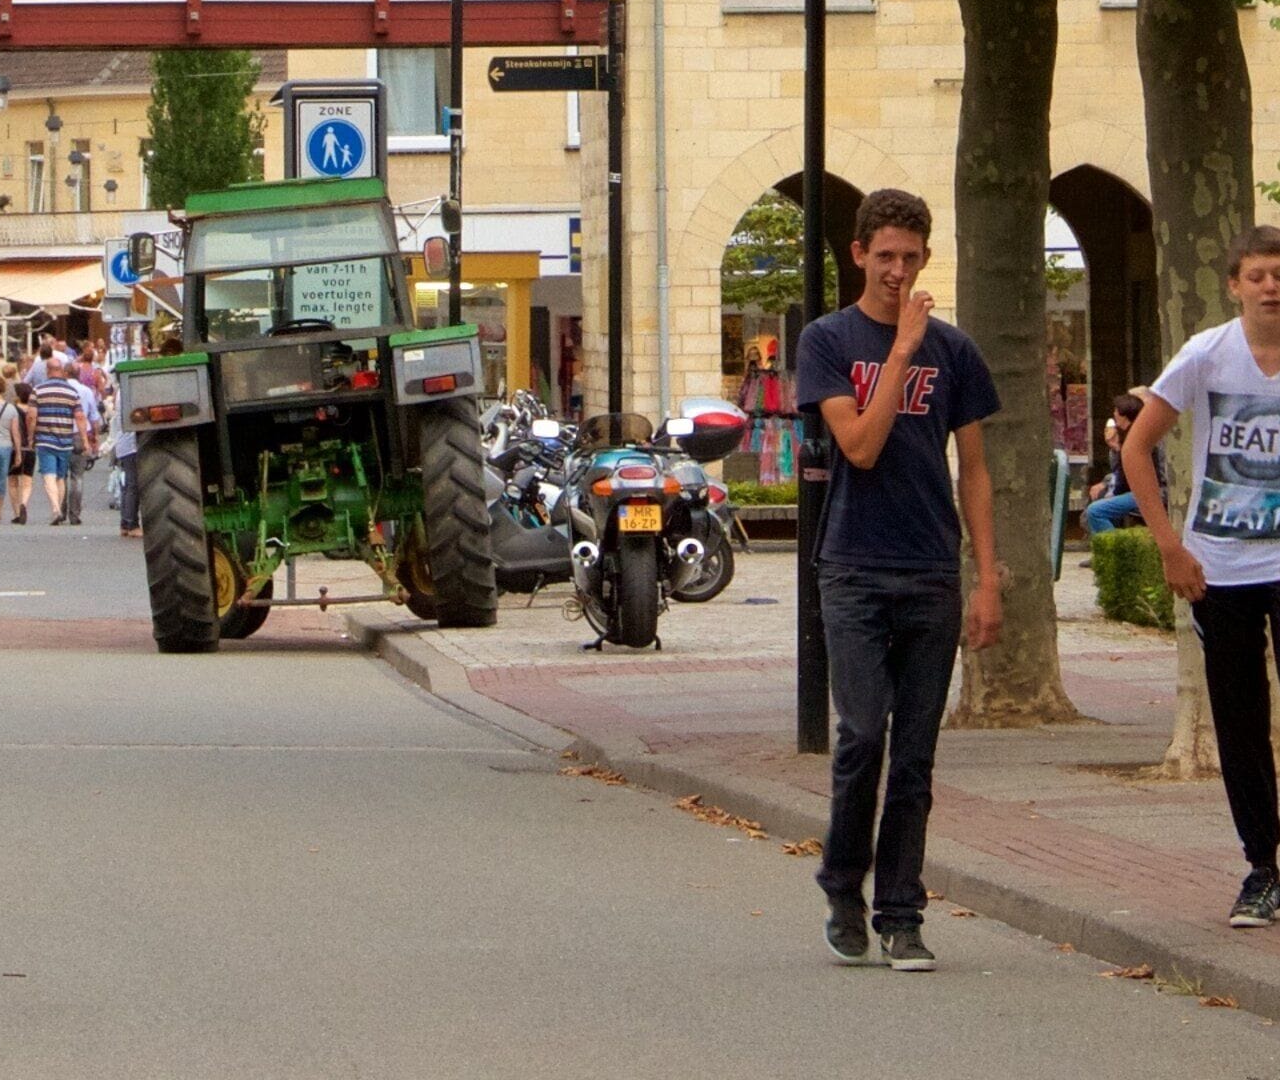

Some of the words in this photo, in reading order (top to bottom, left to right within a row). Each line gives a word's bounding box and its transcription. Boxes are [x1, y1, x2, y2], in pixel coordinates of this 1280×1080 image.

[504, 59, 572, 70] Steenkolenmijn
[318, 106, 353, 116] ZONE
[306, 265, 329, 275] van
[332, 263, 356, 274] 7-11
[360, 263, 367, 273] h
[322, 278, 352, 287] voor
[301, 290, 373, 302] voertuigen
[300, 303, 329, 313] max.
[333, 301, 375, 314] lengte
[340, 316, 352, 325] m
[850, 360, 940, 415] NKE
[1219, 423, 1279, 454] BEAT
[1204, 498, 1269, 531] PLAY
[623, 518, 658, 529] 16-ZP
